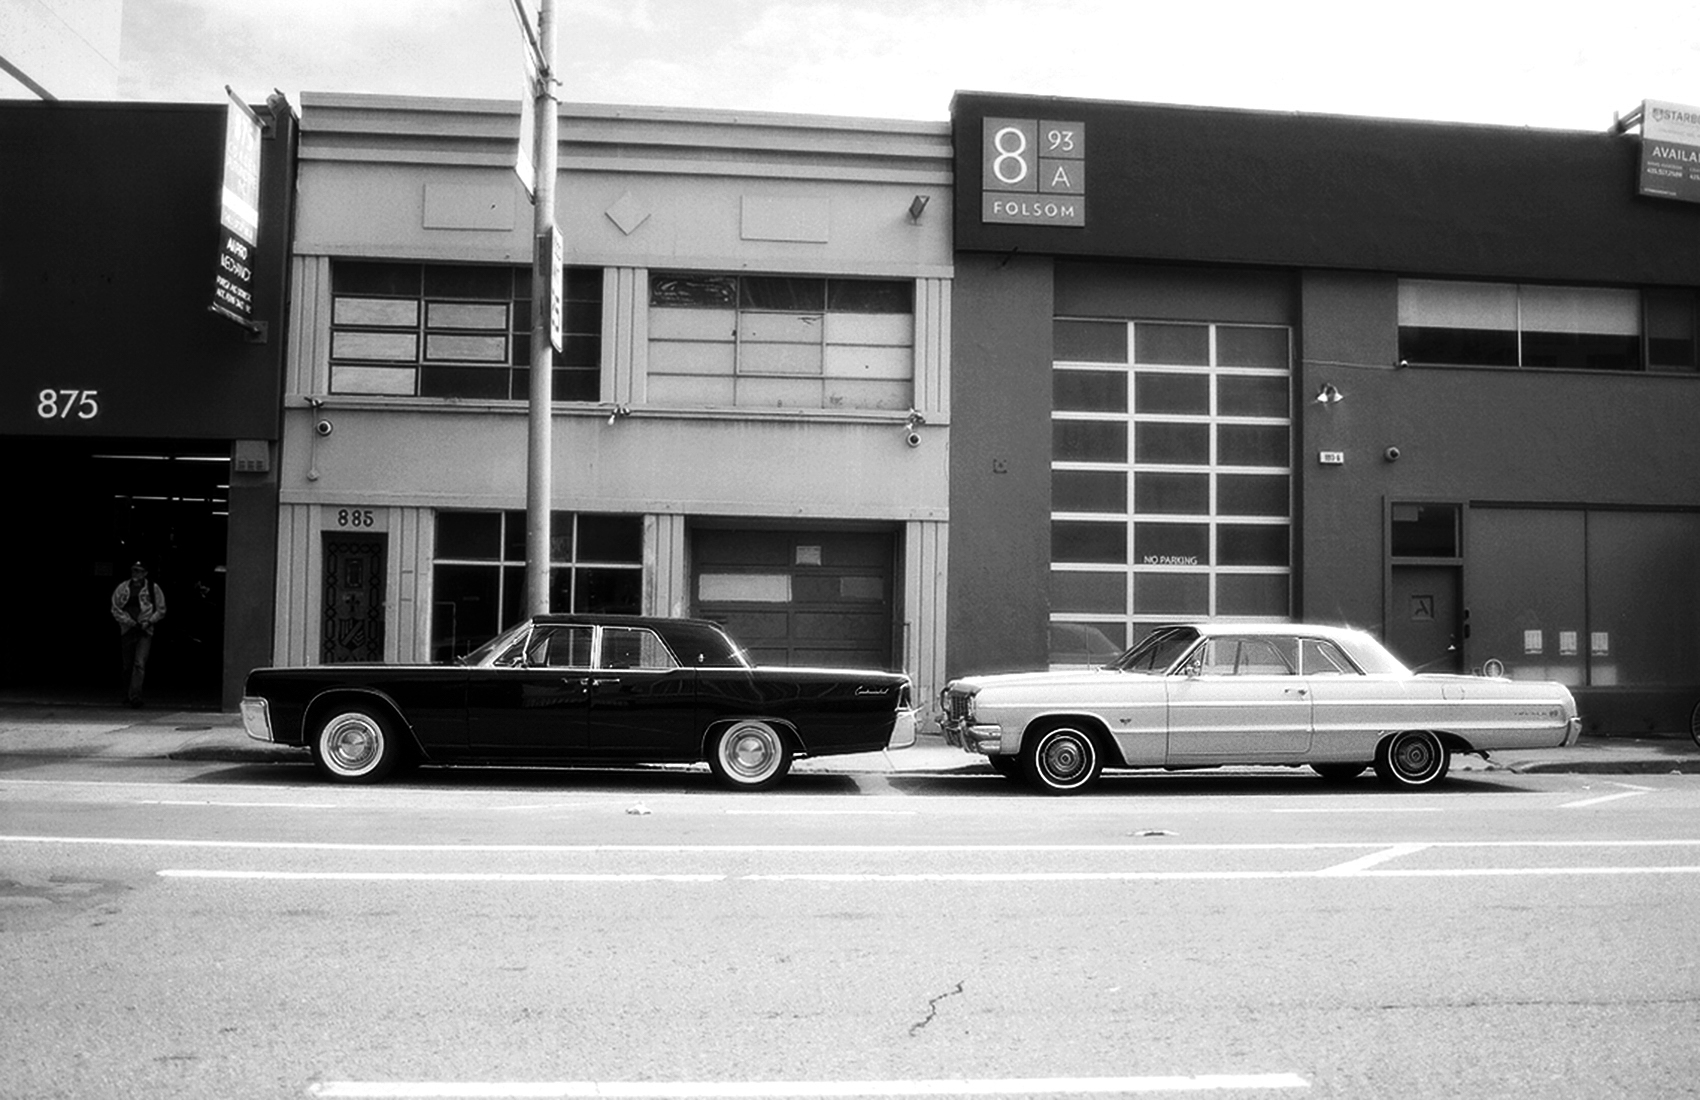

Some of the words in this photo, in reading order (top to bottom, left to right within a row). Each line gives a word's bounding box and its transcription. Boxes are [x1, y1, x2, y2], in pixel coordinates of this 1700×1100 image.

[1048, 130, 1074, 152] 93
[993, 127, 1028, 184] 8
[1652, 146, 1700, 163] AVAILA
[1051, 166, 1070, 187] A
[993, 201, 1075, 218] FOLSOM
[37, 389, 98, 419] 875
[338, 508, 374, 528] 885
[1143, 555, 1159, 565] NO
[1160, 555, 1198, 566] PARKING
